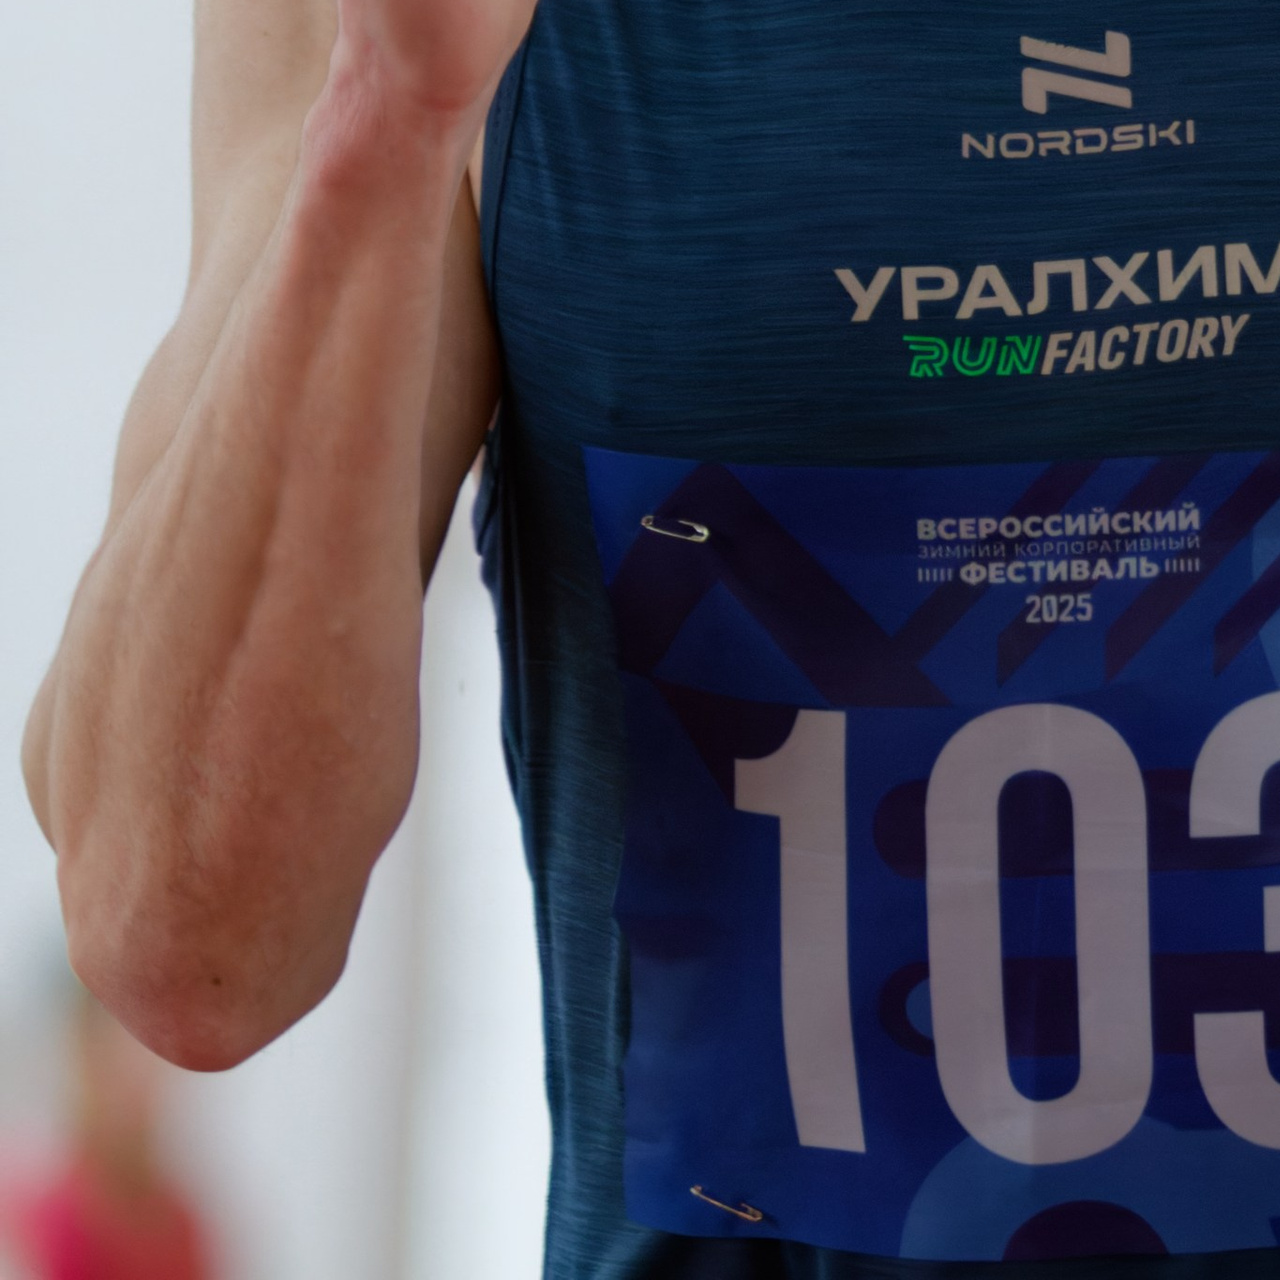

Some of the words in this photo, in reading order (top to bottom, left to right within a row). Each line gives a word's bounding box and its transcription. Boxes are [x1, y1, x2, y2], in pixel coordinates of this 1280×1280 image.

[961, 119, 1196, 159] NORDSKI
[917, 503, 1200, 540] ВСЕРОССИЙСКИЙ
[917, 541, 1007, 560] ЗИМНИЙ
[1014, 534, 1201, 558] КОРПОРАТИВНЫЙ
[959, 556, 1160, 586] ФЕСТИВАЛЬ
[1025, 593, 1094, 624] 2025
